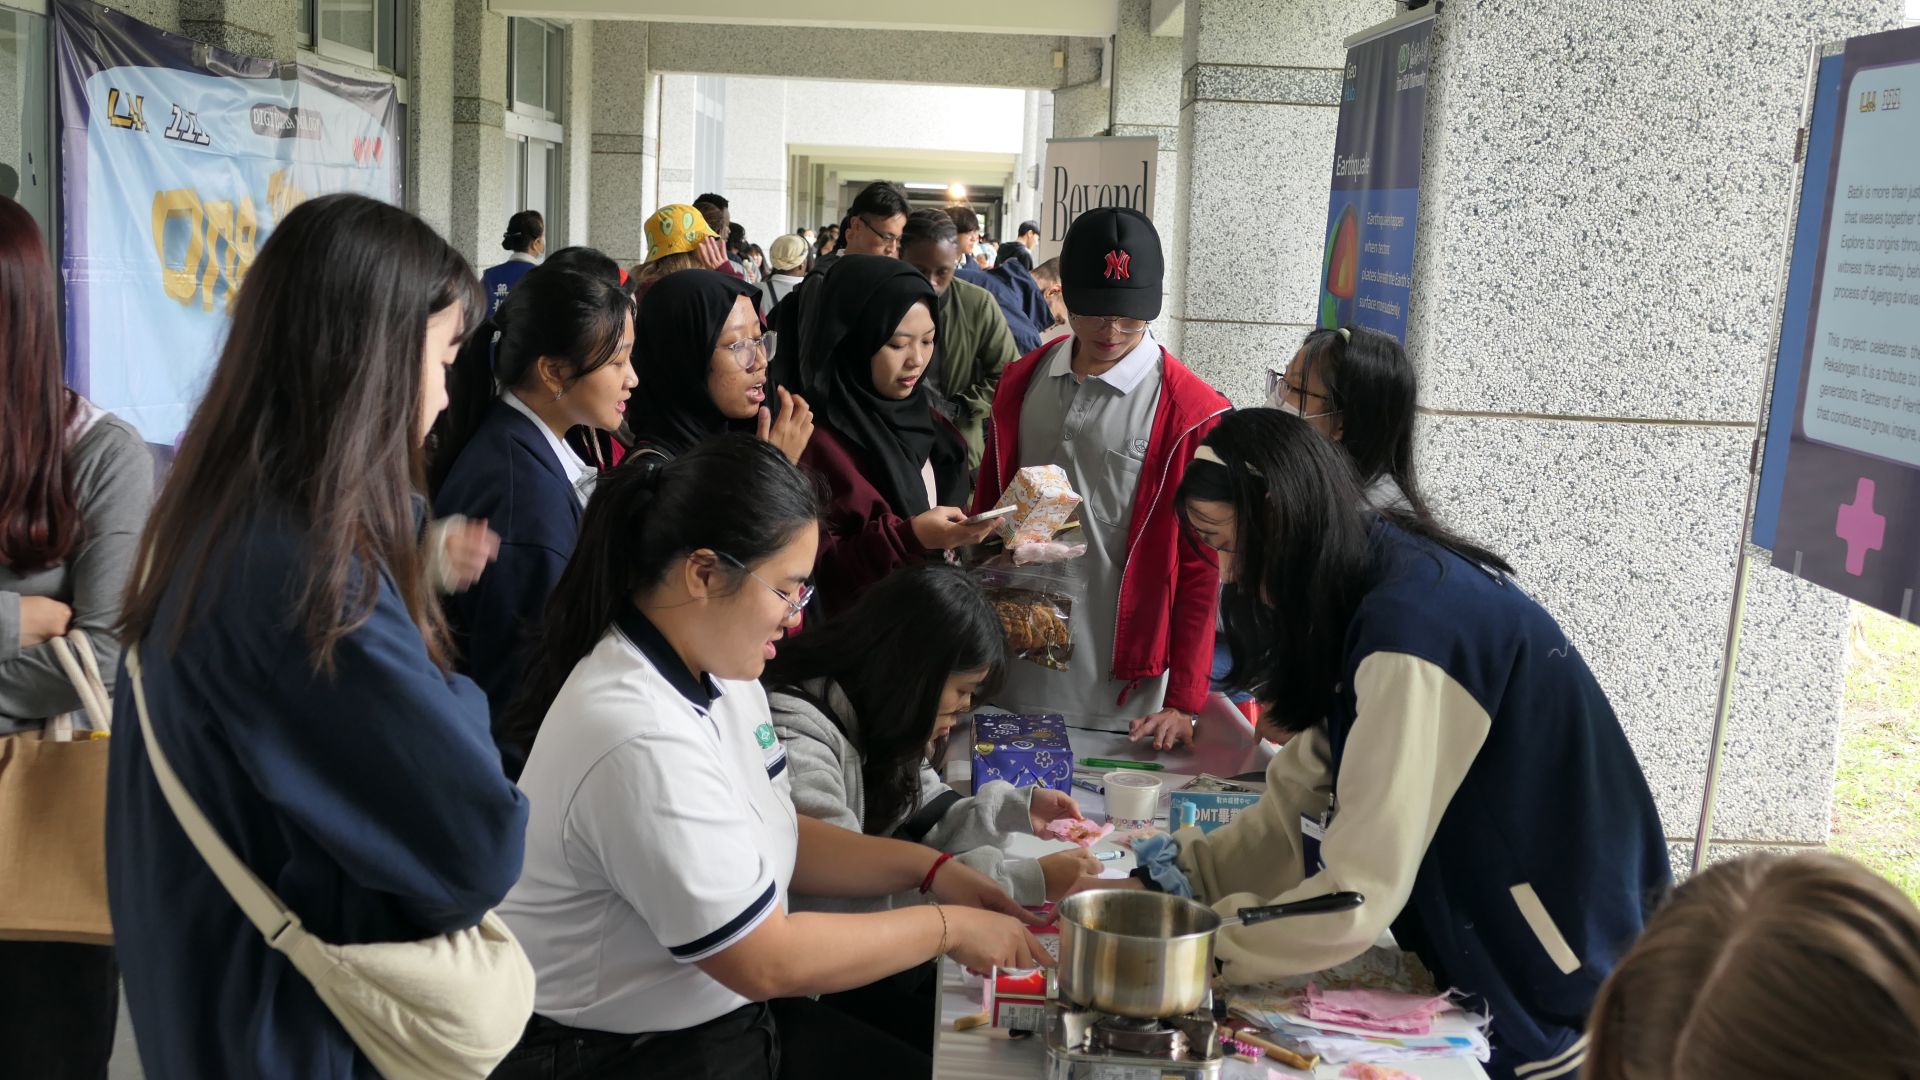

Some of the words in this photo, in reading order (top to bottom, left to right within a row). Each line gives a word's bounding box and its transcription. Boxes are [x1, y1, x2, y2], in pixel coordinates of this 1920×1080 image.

[1346, 62, 1357, 80] Geo
[1847, 185, 1863, 199] Batik
[1865, 186, 1871, 199] is
[1872, 188, 1890, 199] more
[1891, 186, 1907, 199] than
[1844, 210, 1857, 224] that
[1859, 212, 1883, 224] weaves
[1885, 210, 1915, 229] together
[1841, 234, 1864, 252] Explore
[1866, 236, 1875, 250] its
[1876, 236, 1900, 254] origins
[1837, 260, 1862, 274] witness
[1864, 261, 1875, 275] the
[1877, 263, 1904, 281] artistry
[1832, 286, 1861, 301] process
[1861, 285, 1869, 300] of
[1892, 290, 1907, 305] and
[1828, 332, 1840, 347] This
[1842, 337, 1867, 353] project
[1869, 340, 1907, 358] celebrates
[1869, 365, 1875, 379] is
[1882, 368, 1907, 385] tribute
[1908, 372, 1917, 386] to
[1860, 388, 1891, 408] Patterns
[1891, 395, 1901, 410] of
[1817, 406, 1830, 421] that
[1830, 410, 1862, 429] continues
[1862, 418, 1871, 431] to
